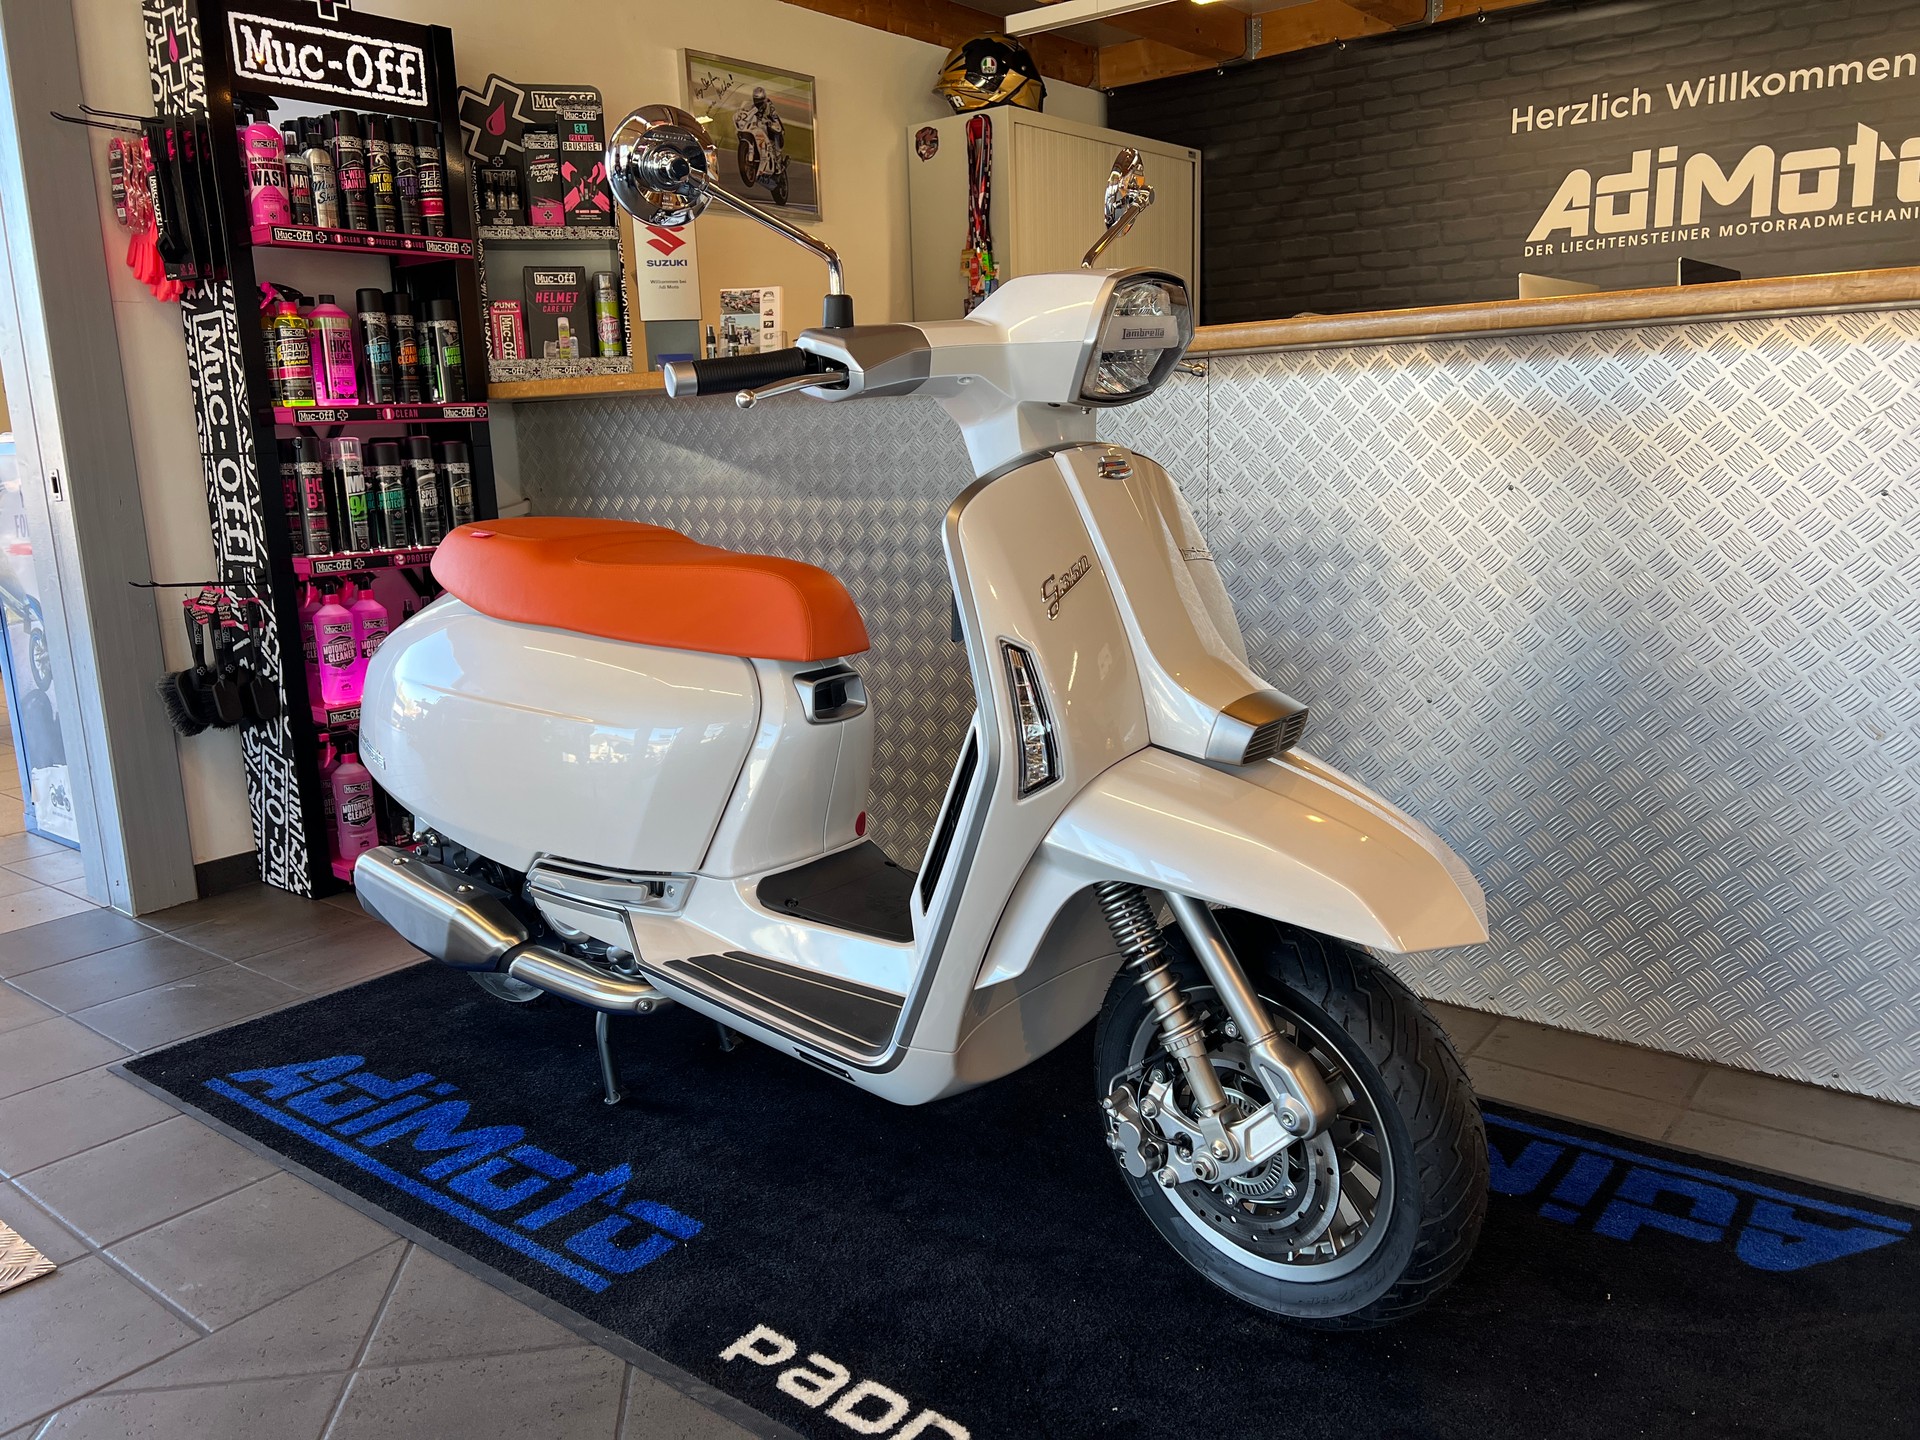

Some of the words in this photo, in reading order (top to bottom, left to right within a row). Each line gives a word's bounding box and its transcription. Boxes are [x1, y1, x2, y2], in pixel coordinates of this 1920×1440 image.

[240, 25, 417, 97] Muc-Off
[1511, 88, 1651, 134] Herzlich
[1666, 52, 1917, 110] Willkommen
[565, 111, 596, 120] Muc-Off
[575, 124, 587, 133] 3X
[563, 142, 587, 151] BRUSH
[588, 142, 602, 151] SET
[251, 170, 286, 188] WASH
[276, 230, 312, 241] Muc-Off
[428, 242, 458, 253] Muc-Off
[1524, 243, 1554, 257] DER
[1561, 227, 1710, 253] LIECHTENSTEINER
[646, 259, 688, 267] SUZUKI
[535, 274, 576, 284] Muc-Off
[535, 292, 579, 303] HELMET
[561, 305, 573, 313] KIT
[280, 342, 308, 351] DRIVE
[281, 350, 308, 359] TRAIN
[299, 411, 334, 421] Muc-Off
[395, 409, 419, 418] CLEAN
[443, 408, 475, 418] Muc-Off
[198, 324, 251, 552] Muc-Off
[317, 561, 351, 572] Muc-Off
[407, 553, 433, 563] PROTEC
[324, 624, 352, 634] Muc-Off
[328, 649, 355, 663] CLEANER
[265, 753, 286, 889] uc-Off
[227, 1055, 704, 1274] AdiMoto
